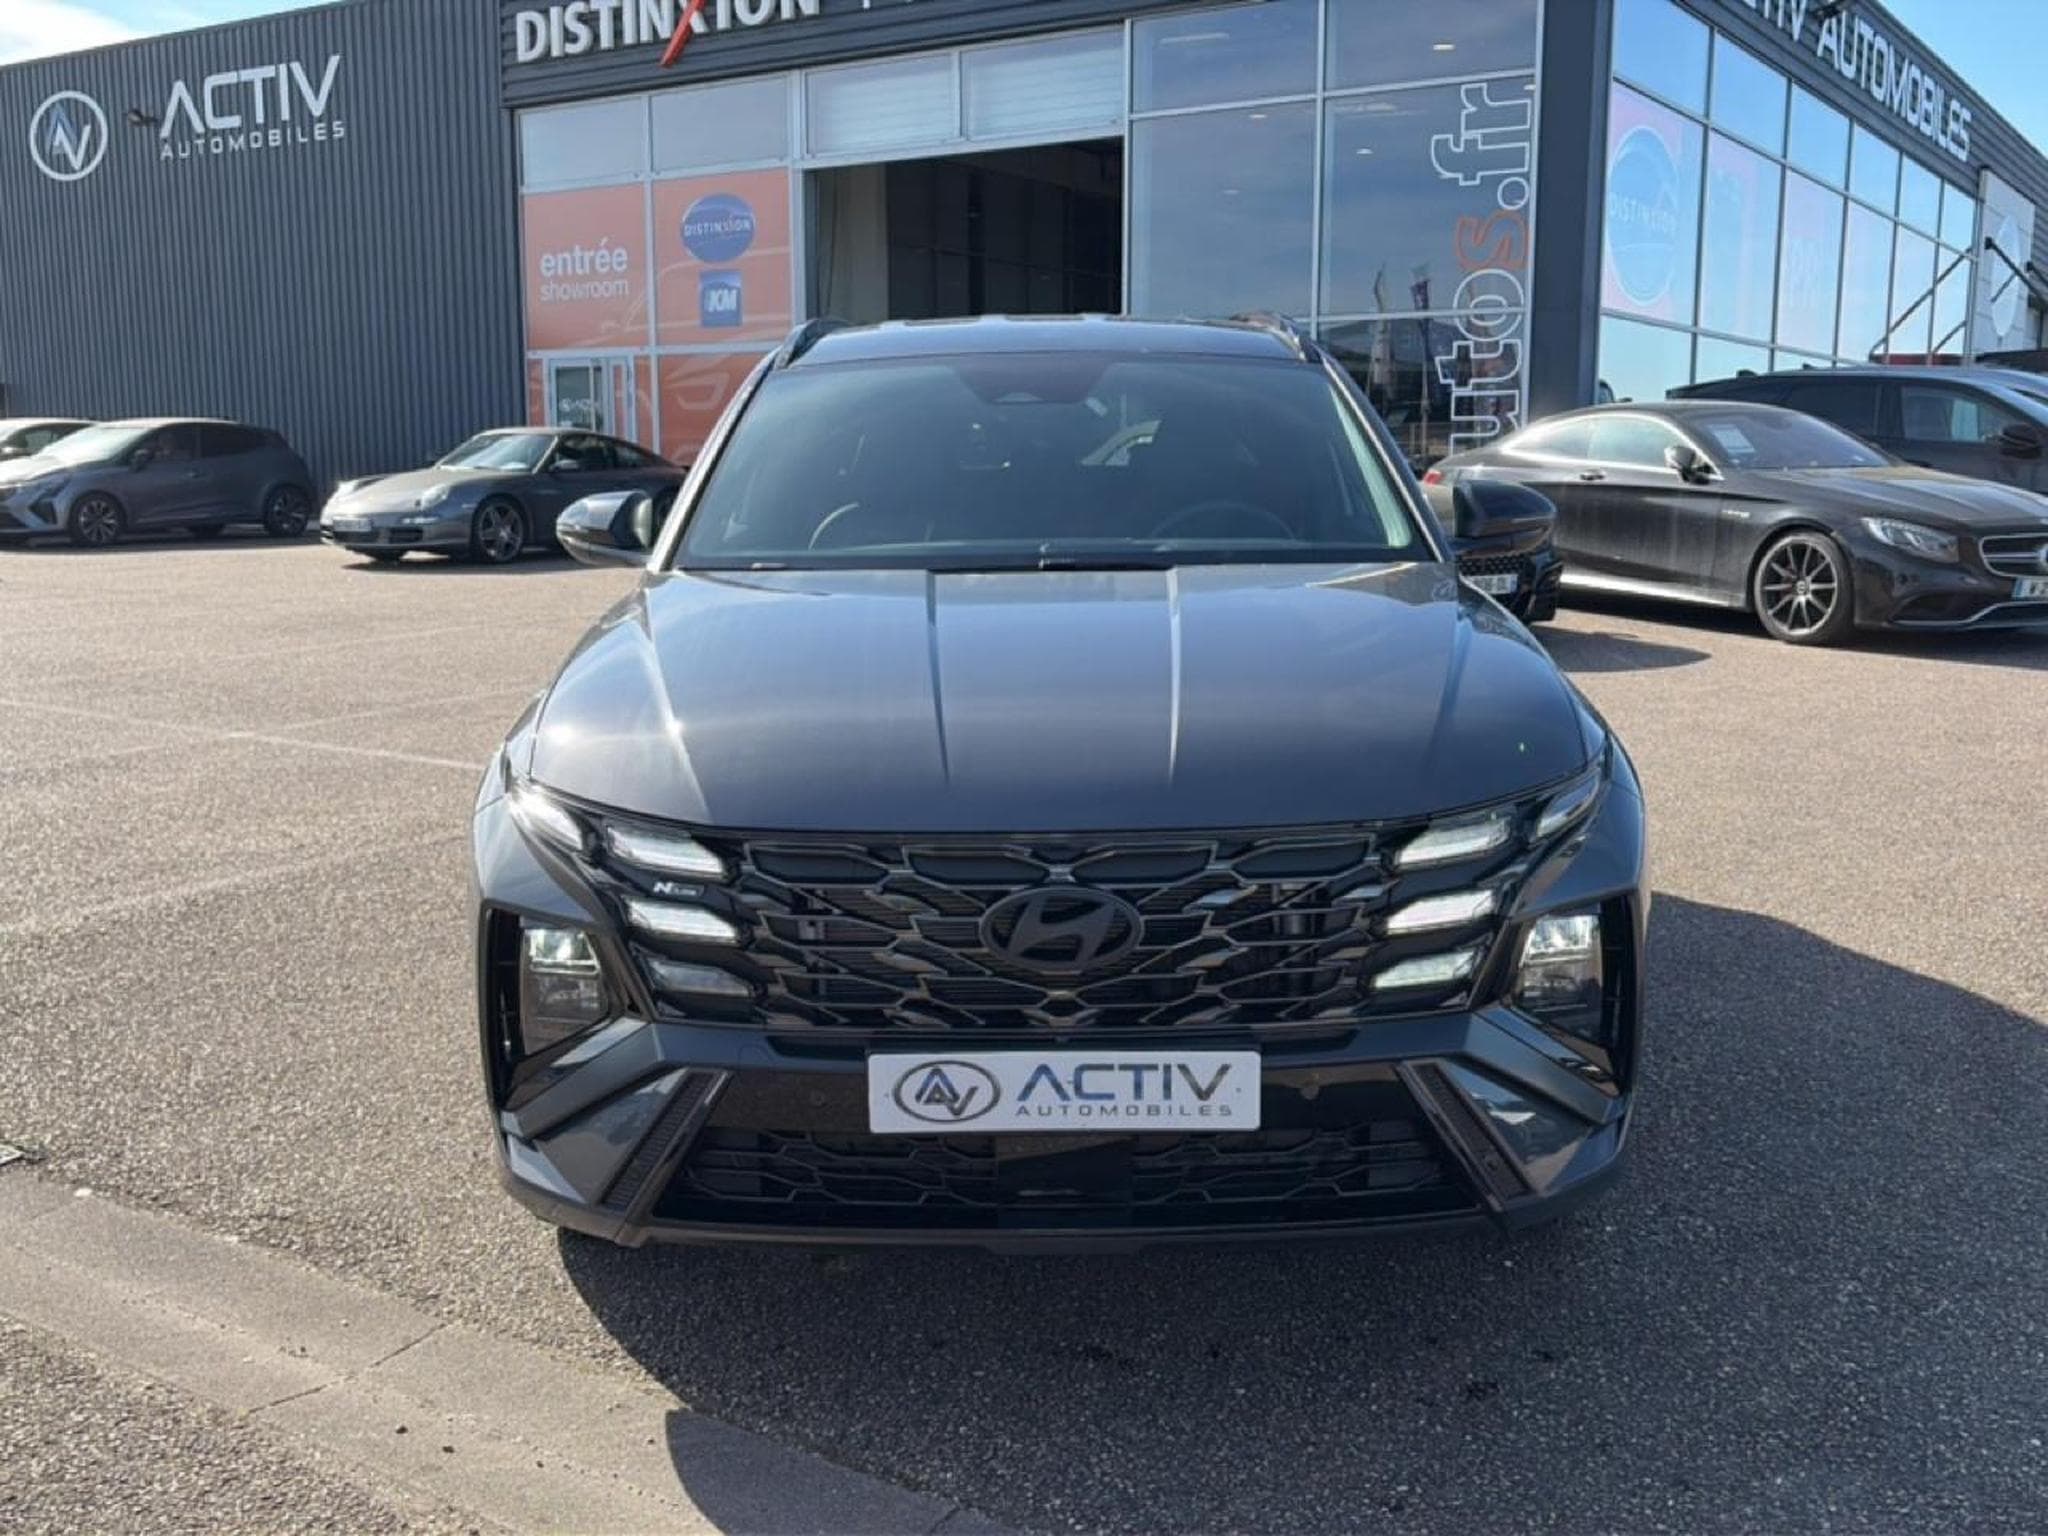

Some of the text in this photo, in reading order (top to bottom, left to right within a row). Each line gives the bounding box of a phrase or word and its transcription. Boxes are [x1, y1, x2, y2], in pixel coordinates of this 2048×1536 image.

[160, 54, 341, 139] ACTIV
[1816, 9, 1973, 163] AUTOMOBILES
[160, 120, 346, 162] AUTOMOBILES
[540, 237, 629, 278] entrée
[539, 278, 630, 302] showroom
[1016, 1063, 1232, 1101] ACTIV
[1015, 1104, 1233, 1117] AUTOMOBILES
